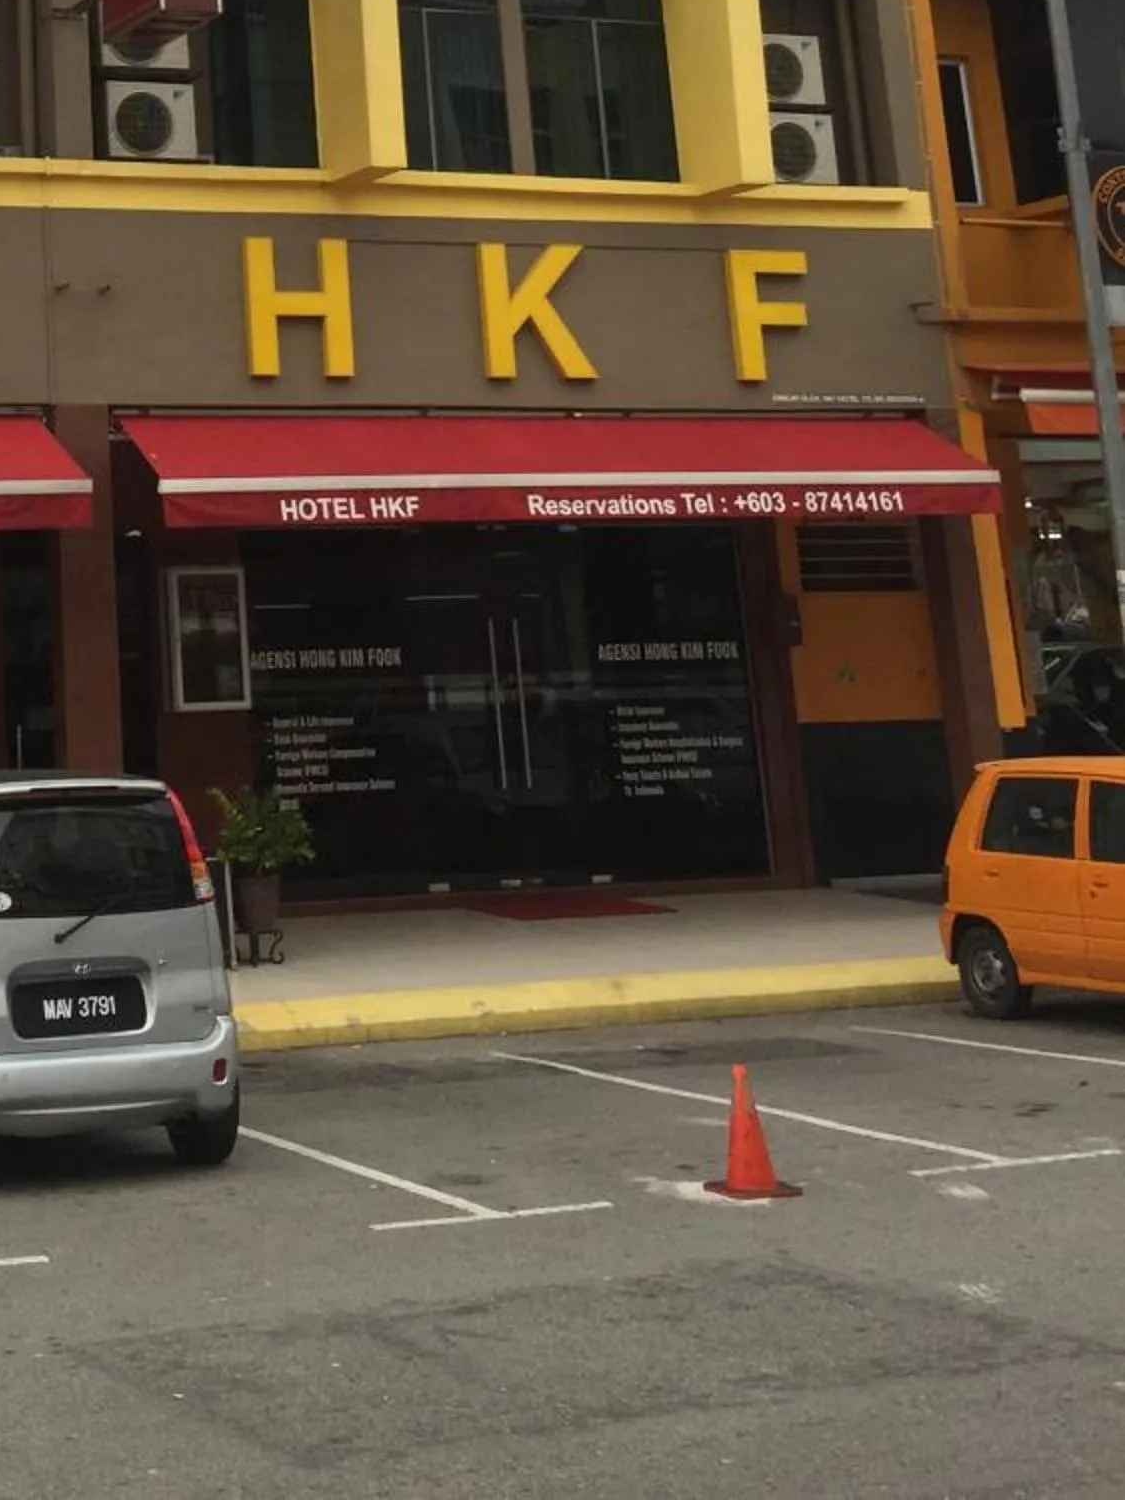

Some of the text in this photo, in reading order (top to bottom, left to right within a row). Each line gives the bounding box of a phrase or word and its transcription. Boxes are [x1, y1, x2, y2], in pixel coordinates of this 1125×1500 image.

[279, 495, 420, 522] HOTEL HKF
[527, 494, 676, 516] Reservations
[679, 492, 715, 515] Tel
[734, 490, 786, 513] +603
[805, 490, 905, 513] 87414161
[250, 646, 403, 671] AGENSI HONG KIM FOOK
[597, 642, 642, 662] AGENSI
[644, 642, 679, 661] HONG
[43, 995, 117, 1020] MAV 3791
